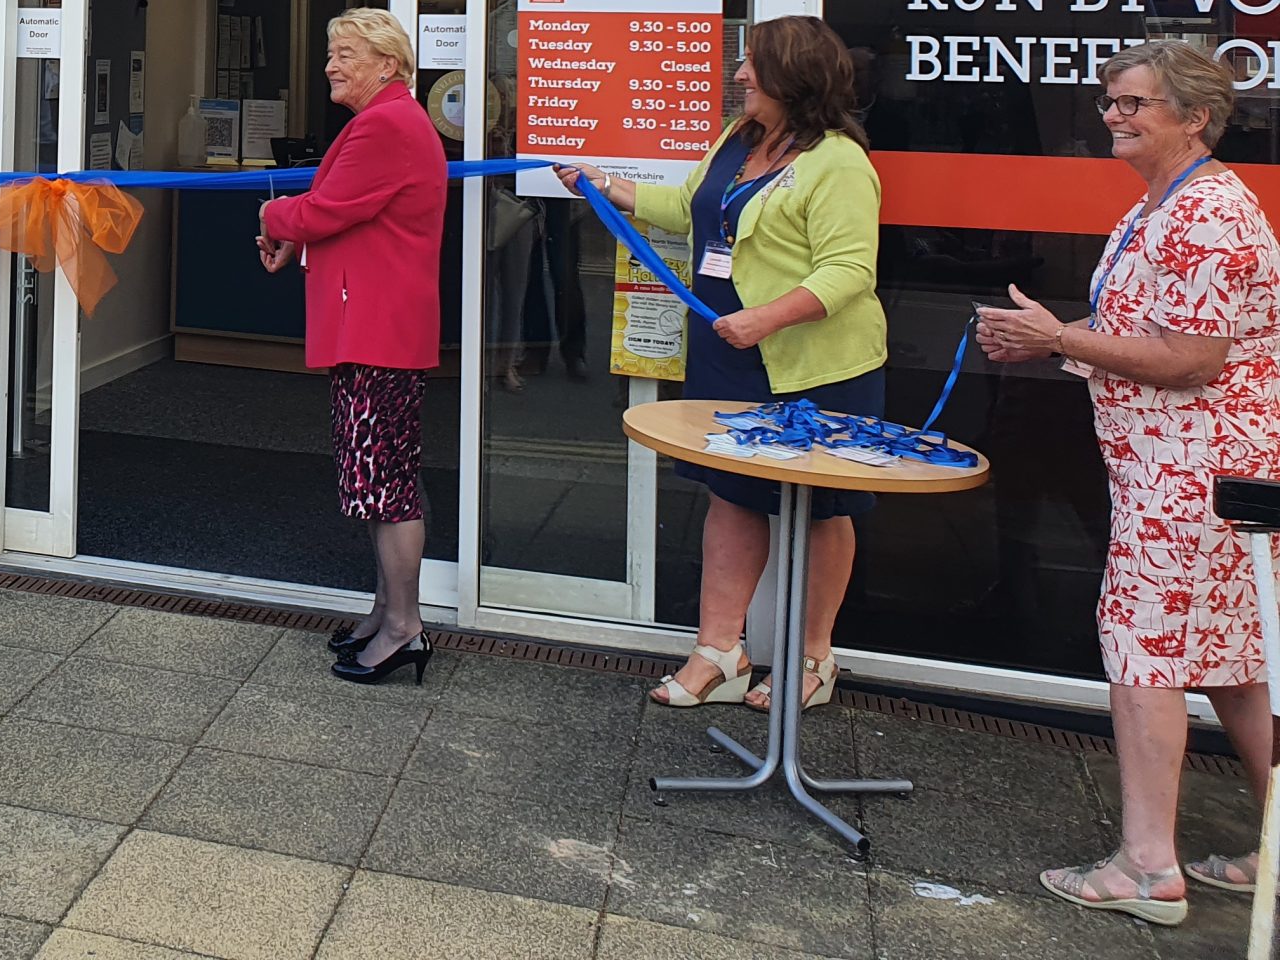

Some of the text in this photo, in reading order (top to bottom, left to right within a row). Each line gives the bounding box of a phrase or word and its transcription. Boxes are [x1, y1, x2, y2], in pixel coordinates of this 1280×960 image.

[20, 17, 60, 25] Automatic
[528, 19, 590, 34] Monday
[629, 20, 663, 33] 9.30
[676, 22, 712, 33] 5.00
[423, 25, 465, 34] Automati
[528, 38, 593, 53] Tuesday
[629, 40, 663, 52] 9.30
[676, 41, 712, 53] 5.00
[528, 57, 711, 73] Wednesday Closed
[906, 35, 1188, 86] BENEF
[528, 76, 601, 91] Thursday
[628, 79, 663, 91] 9.30
[676, 80, 711, 92] 5.00
[528, 95, 578, 110] Friday
[631, 98, 666, 110] 9.30
[678, 100, 711, 111] 1.00
[528, 114, 599, 130] Saturday
[622, 117, 657, 129] 9.30
[669, 119, 711, 131] 12.30
[527, 133, 710, 151] Sunday Closed
[622, 171, 665, 180] Yorkshire
[22, 253, 34, 305] SEL
